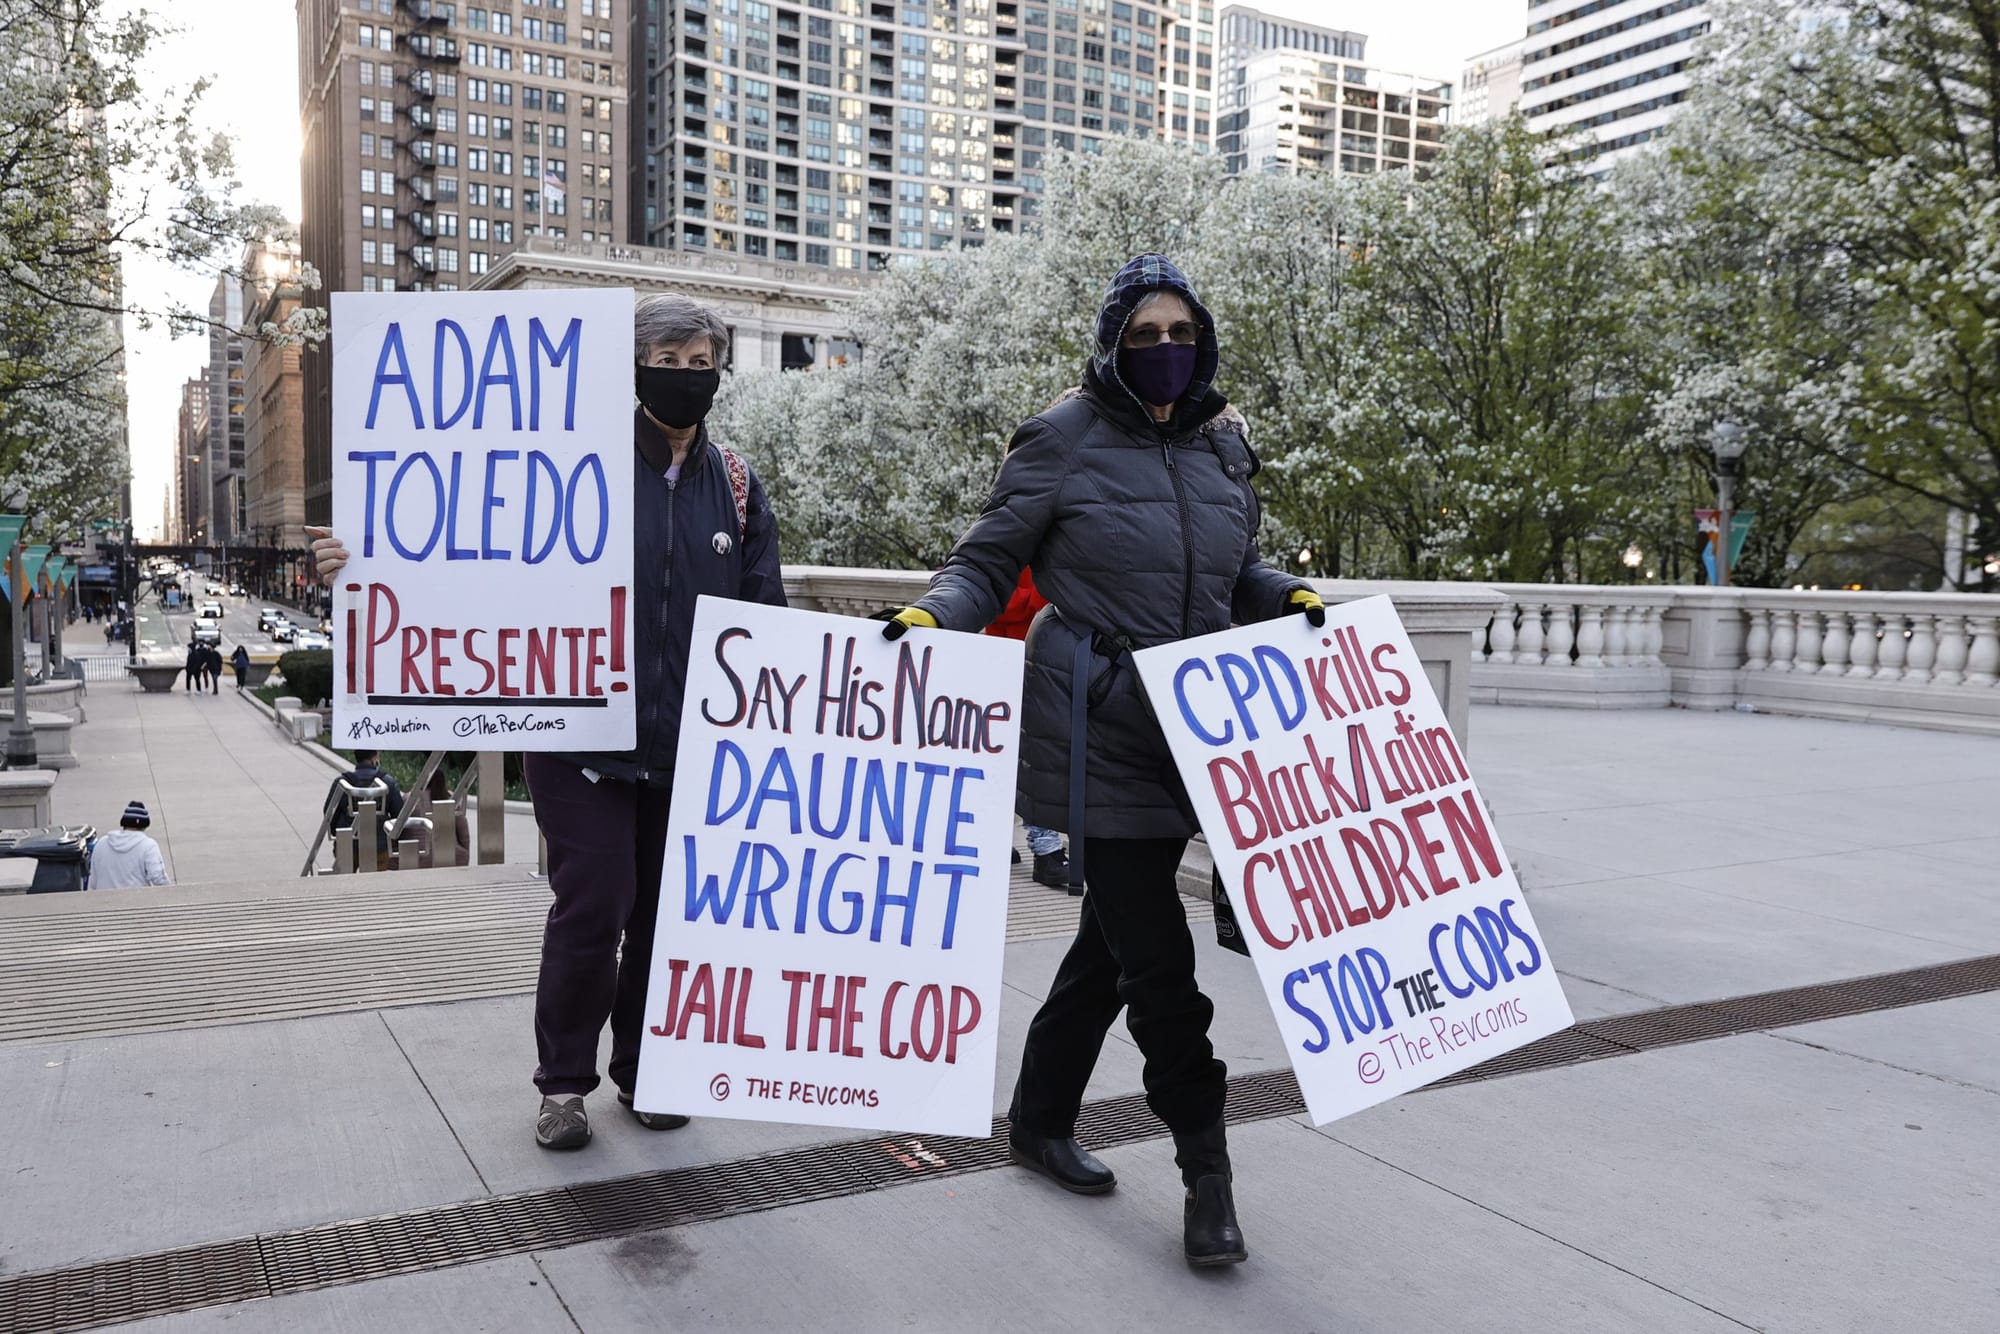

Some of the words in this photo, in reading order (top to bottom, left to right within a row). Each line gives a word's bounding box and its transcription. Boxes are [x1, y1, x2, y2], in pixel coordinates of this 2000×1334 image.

[364, 315, 582, 431] ADAM
[348, 449, 610, 565] TOLEDO
[348, 716, 431, 740] #Revolution
[453, 713, 567, 738] @TheRevComs
[816, 632, 886, 741] His
[892, 641, 1012, 754] Name
[1172, 645, 1308, 747] CPD
[1305, 625, 1411, 721] kills
[704, 739, 985, 857] DAUNTE
[683, 835, 980, 950] WRIGHT
[1242, 789, 1503, 950] CHILDREN
[650, 959, 766, 1049] JAIL
[781, 969, 867, 1057] THE
[879, 981, 981, 1064] COP
[1282, 947, 1393, 1054] STOP
[1393, 968, 1446, 1018] THE
[1428, 899, 1542, 999] COPS
[746, 1078, 784, 1098] THE
[787, 1081, 880, 1108] REVCOMS
